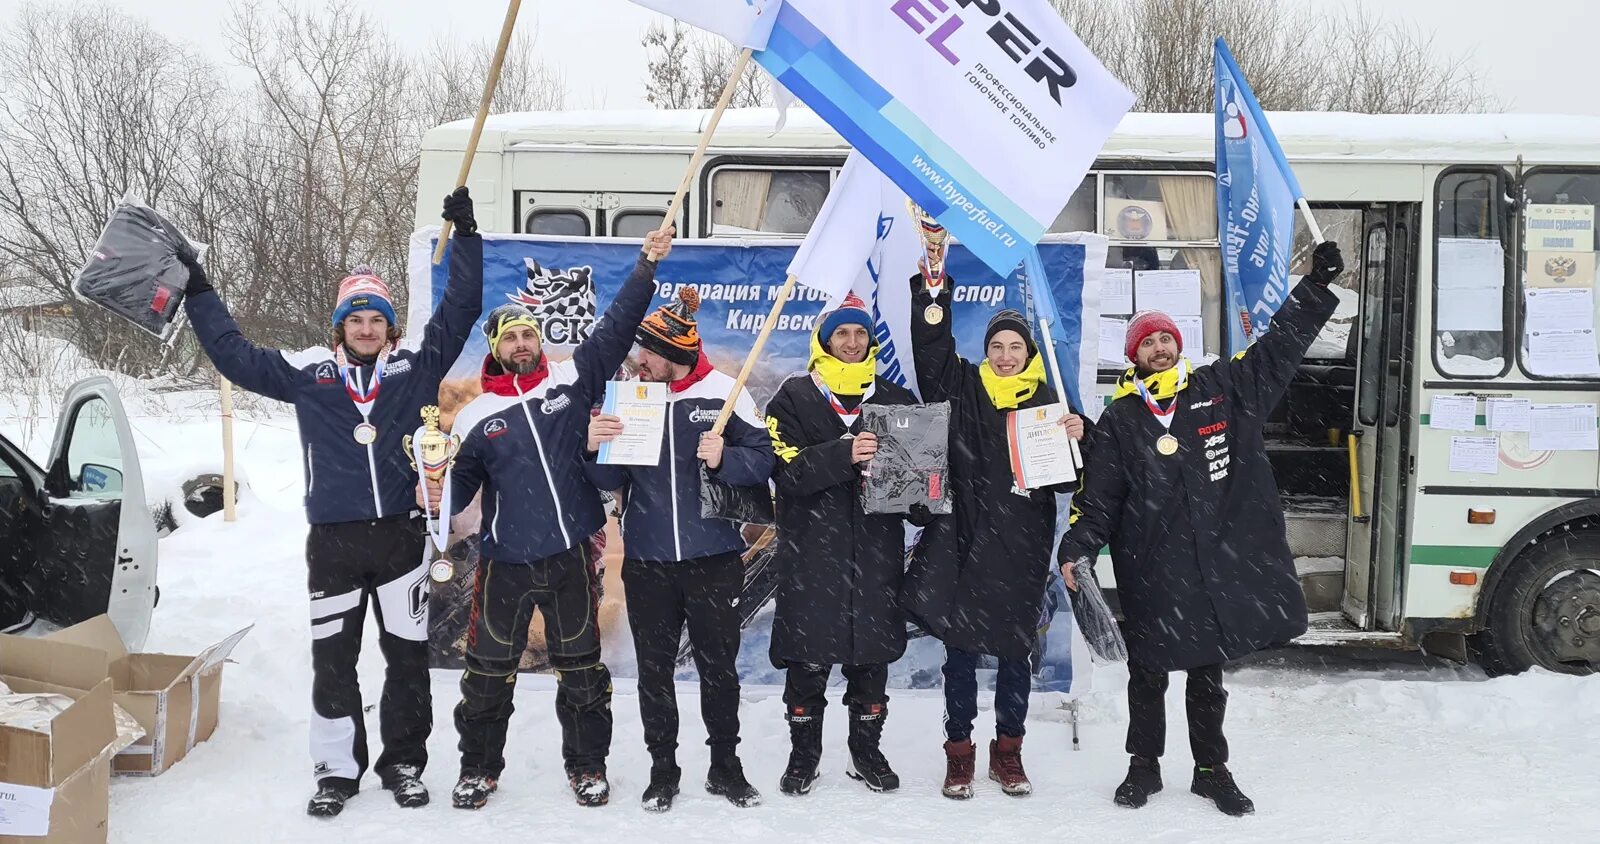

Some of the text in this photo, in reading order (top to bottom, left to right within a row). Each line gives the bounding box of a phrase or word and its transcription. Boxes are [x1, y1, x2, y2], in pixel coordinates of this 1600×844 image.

[964, 71, 1046, 150] ГОНОЧНОЕ ТОПЛИВО
[974, 62, 1057, 144] ПРОФЕССИОНАЛЬНОЕ
[911, 154, 1017, 248] www.hyperfuel.ru
[653, 279, 760, 302] едрация
[726, 309, 816, 335] Кирвск
[1198, 420, 1228, 436] ROTAX
[1204, 433, 1226, 448] XPS
[1210, 468, 1228, 482] NSK
